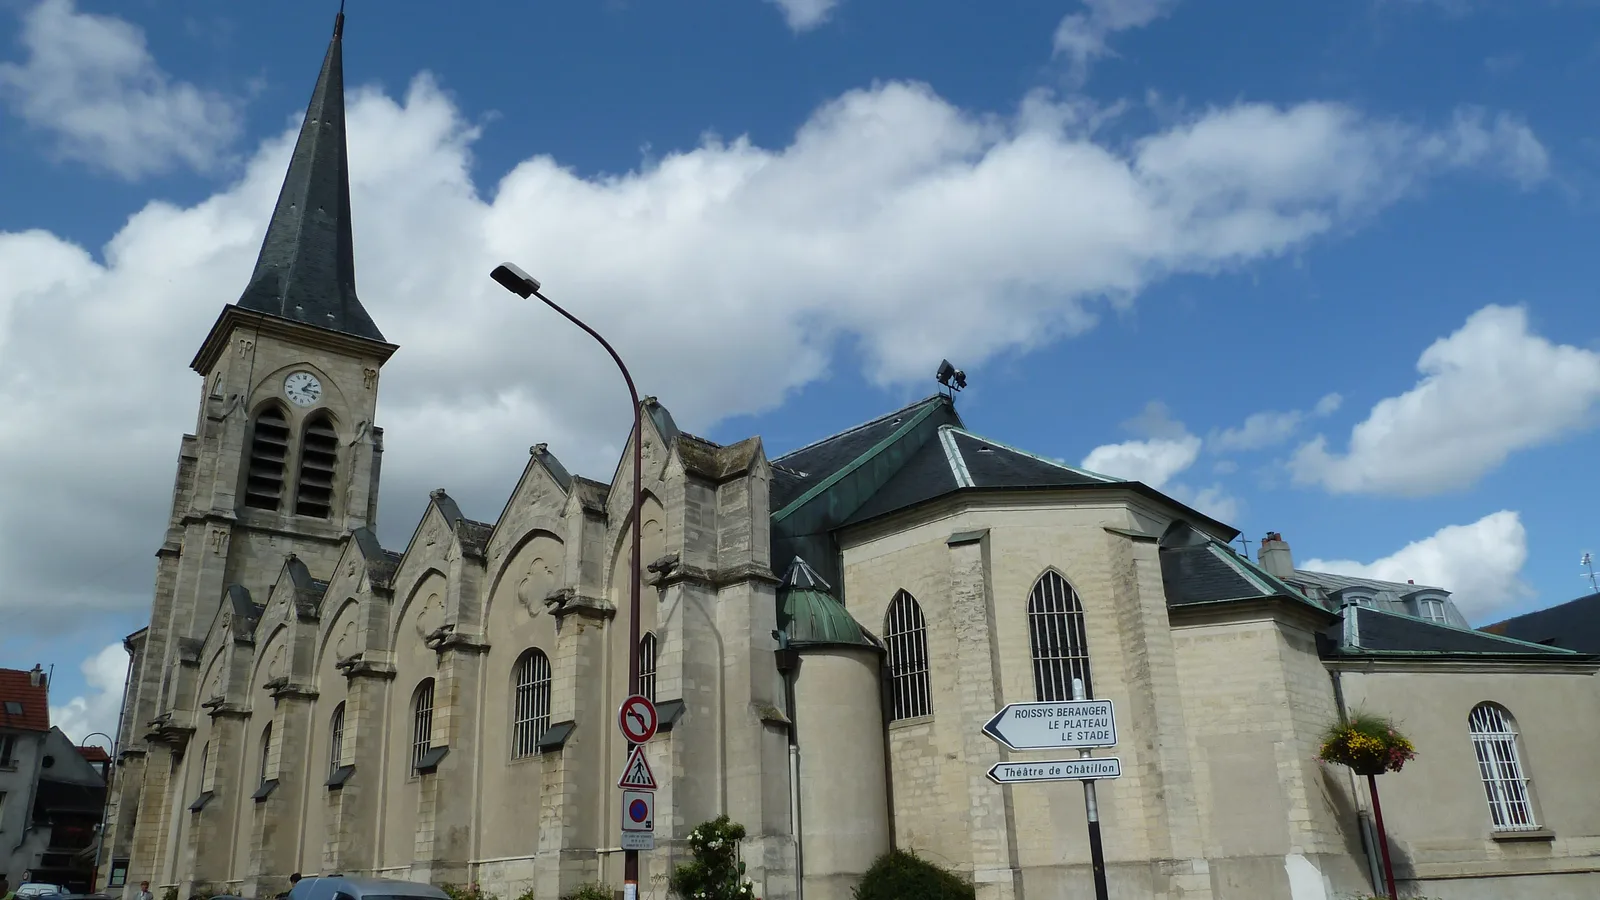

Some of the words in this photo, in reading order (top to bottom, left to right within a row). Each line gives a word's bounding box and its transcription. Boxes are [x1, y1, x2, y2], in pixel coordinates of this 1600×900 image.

[1015, 708, 1053, 719] ROISSYS
[1056, 706, 1107, 717] BERANGER
[1048, 720, 1059, 730] LE
[1063, 718, 1108, 729] PLATEAU
[1062, 732, 1072, 741] LE
[1077, 730, 1109, 740] STADE
[1004, 766, 1044, 777] Théâtre
[1049, 766, 1060, 775] de
[1066, 763, 1115, 774] Châtillon
